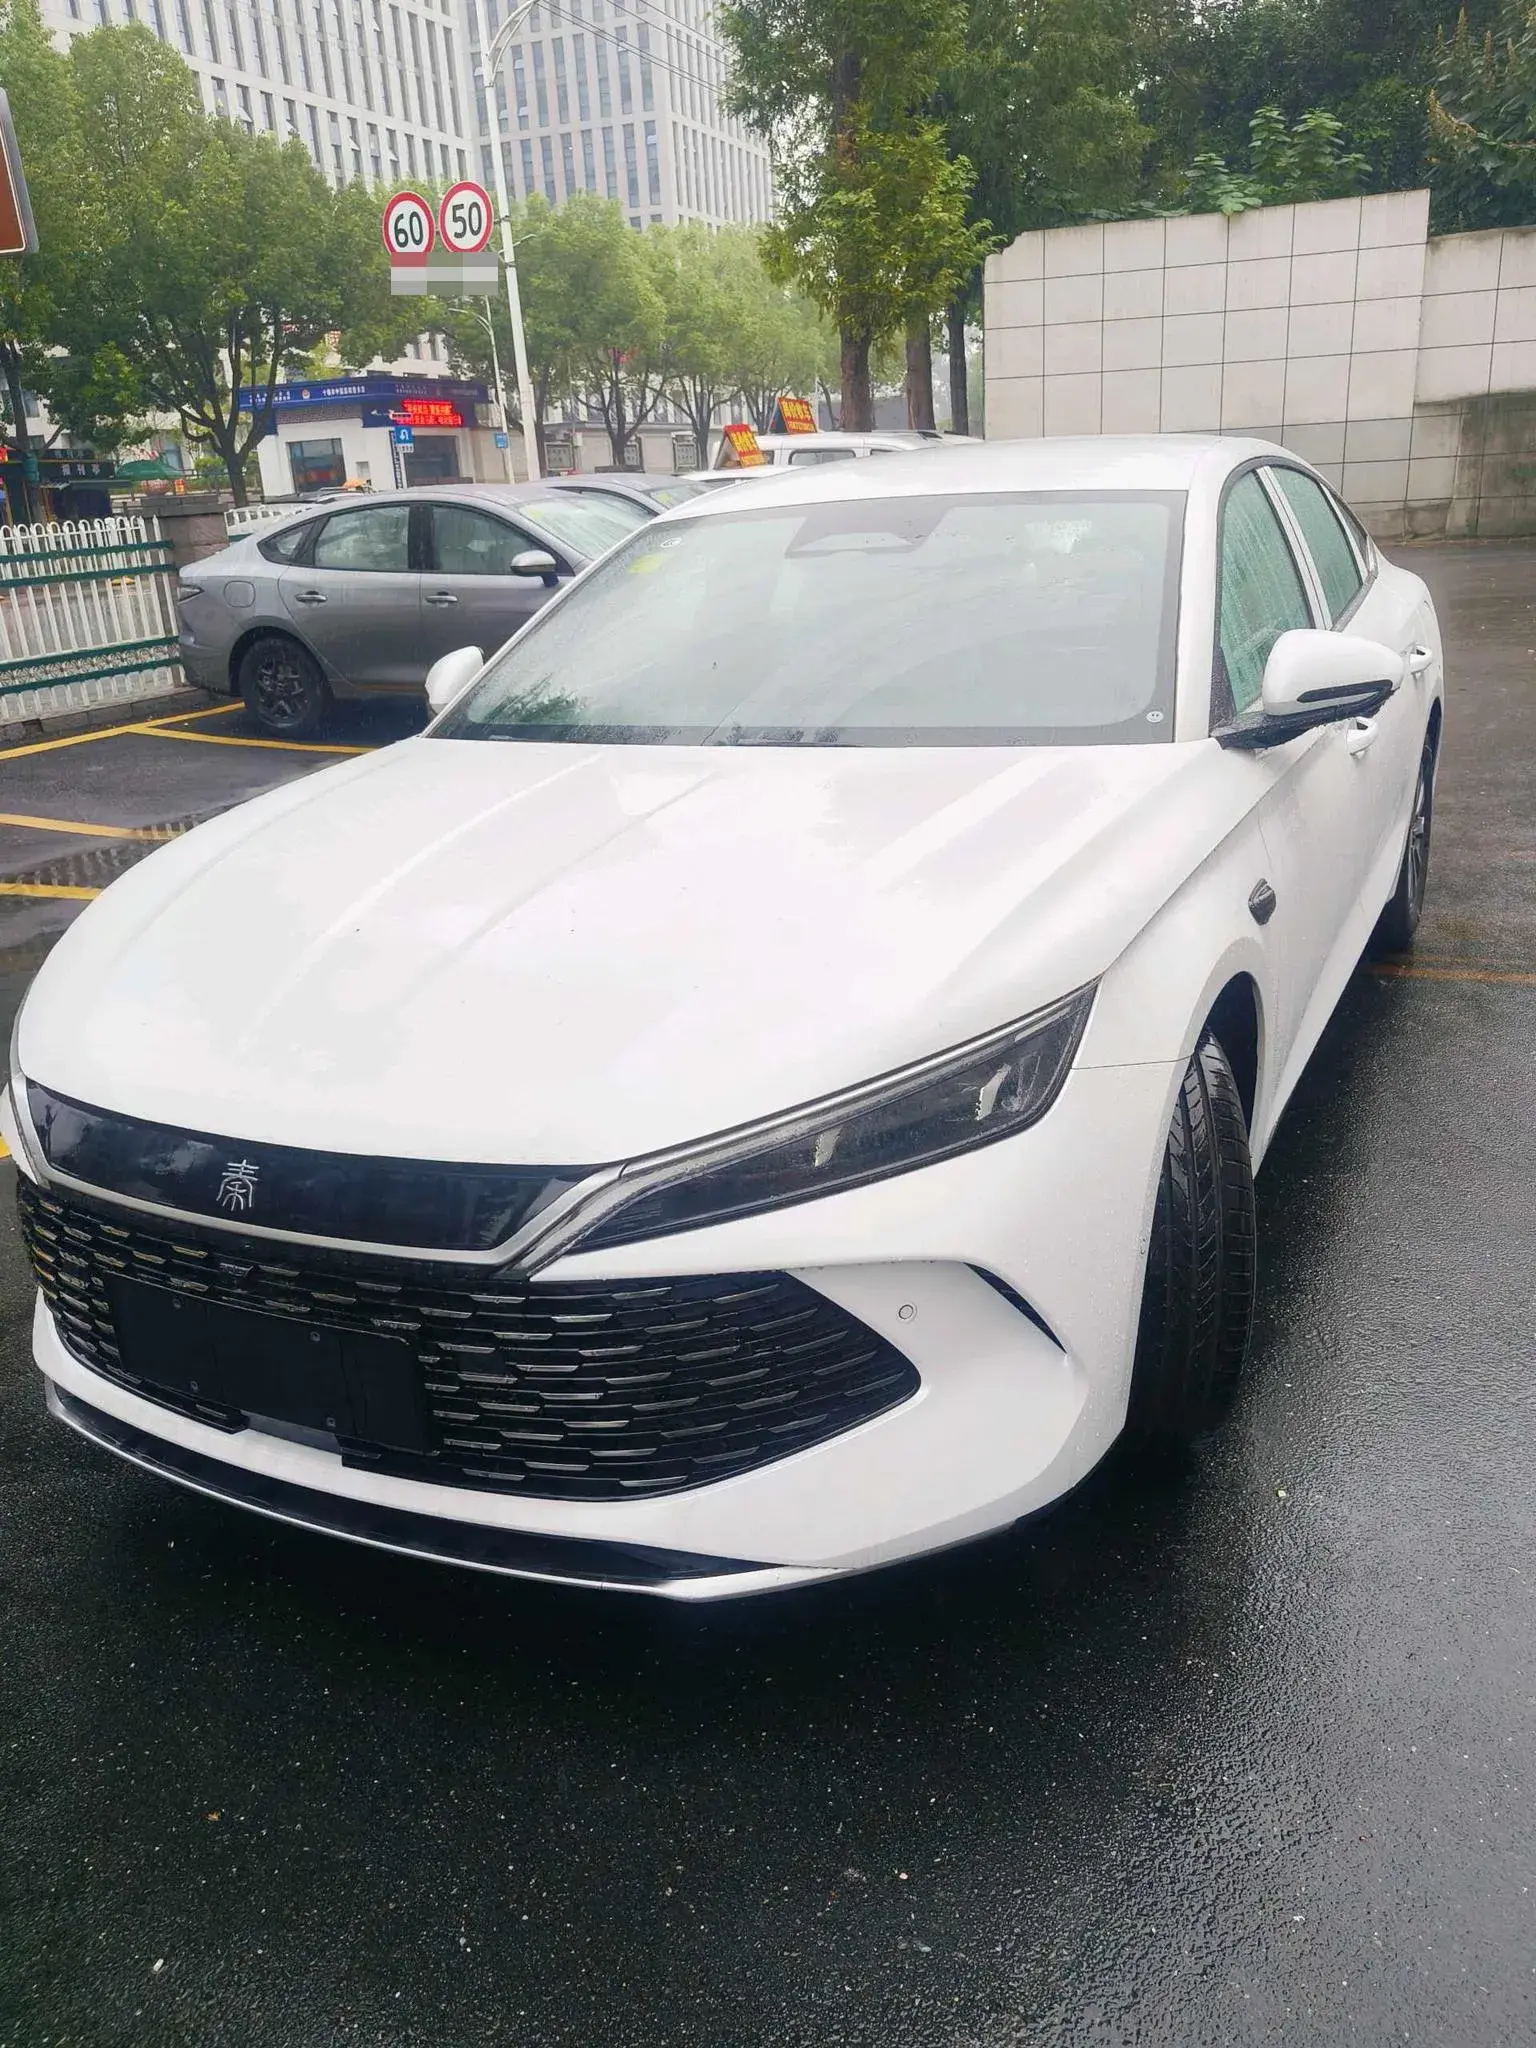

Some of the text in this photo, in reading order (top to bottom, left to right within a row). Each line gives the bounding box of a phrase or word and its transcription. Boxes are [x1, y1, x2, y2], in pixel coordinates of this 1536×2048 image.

[394, 211, 424, 248] 60
[452, 202, 482, 239] 50
[216, 1159, 260, 1212] 秦
